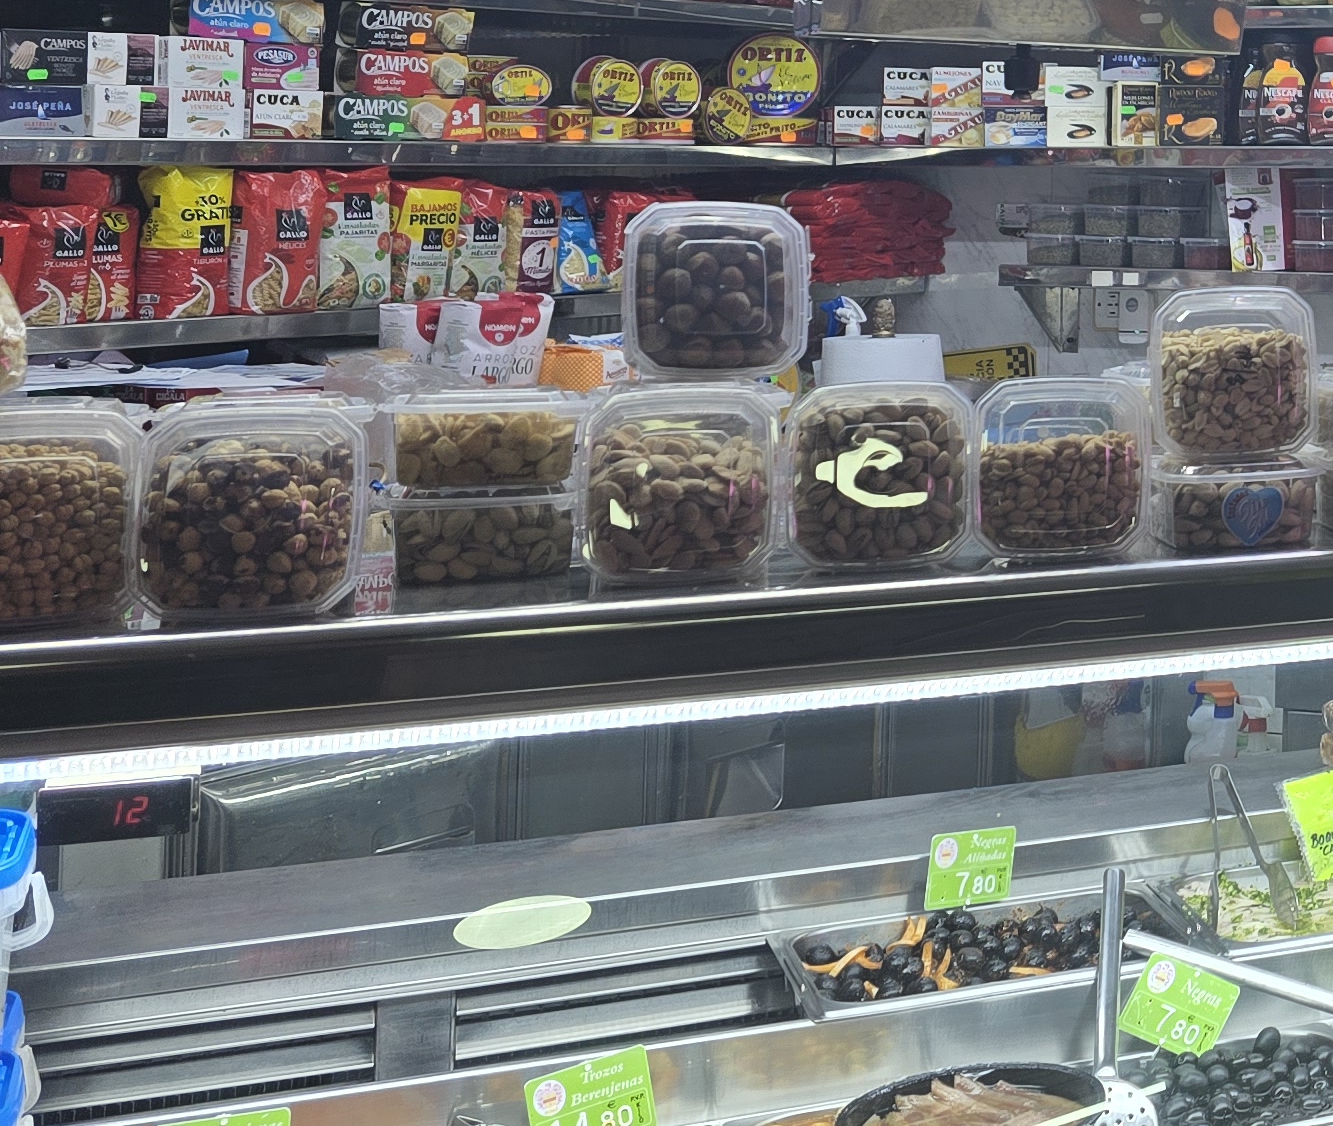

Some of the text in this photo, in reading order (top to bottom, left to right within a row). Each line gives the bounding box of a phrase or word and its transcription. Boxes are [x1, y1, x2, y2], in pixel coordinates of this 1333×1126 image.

[361, 7, 433, 29] CAMPOS
[40, 37, 86, 50] CAMPOS
[180, 38, 234, 58] JAVIMAR
[741, 47, 806, 64] ORTIZ
[360, 52, 429, 74] CAMPOS
[602, 69, 635, 83] ORTIZ
[662, 70, 693, 82] ORTIZ
[886, 70, 930, 81] CUCA
[181, 89, 235, 107] JAVIMAR
[256, 93, 301, 107] CUCA
[9, 100, 72, 111] JOSÉ PEÑA
[337, 96, 409, 119] CAMPOS
[836, 109, 875, 120] CUCA
[883, 109, 927, 120] CUCA
[346, 208, 372, 219] GALLO
[410, 201, 458, 215] BAJAMOS
[408, 212, 458, 227] PRECIO
[533, 217, 555, 225] GALLO
[279, 229, 308, 240] GALLO
[338, 228, 379, 237] PAJARITAS
[474, 233, 498, 242] GALLO
[56, 247, 85, 258] GALLO
[201, 245, 225, 255] GALLO
[422, 243, 443, 252] GALLO
[536, 248, 546, 268] 1
[155, 391, 186, 402] CIGALA
[113, 796, 149, 825] 12
[969, 834, 1007, 849] Negras
[1180, 978, 1222, 1008] Negras
[580, 1062, 624, 1085] Trozos
[570, 1075, 644, 1107] Berenjenas
